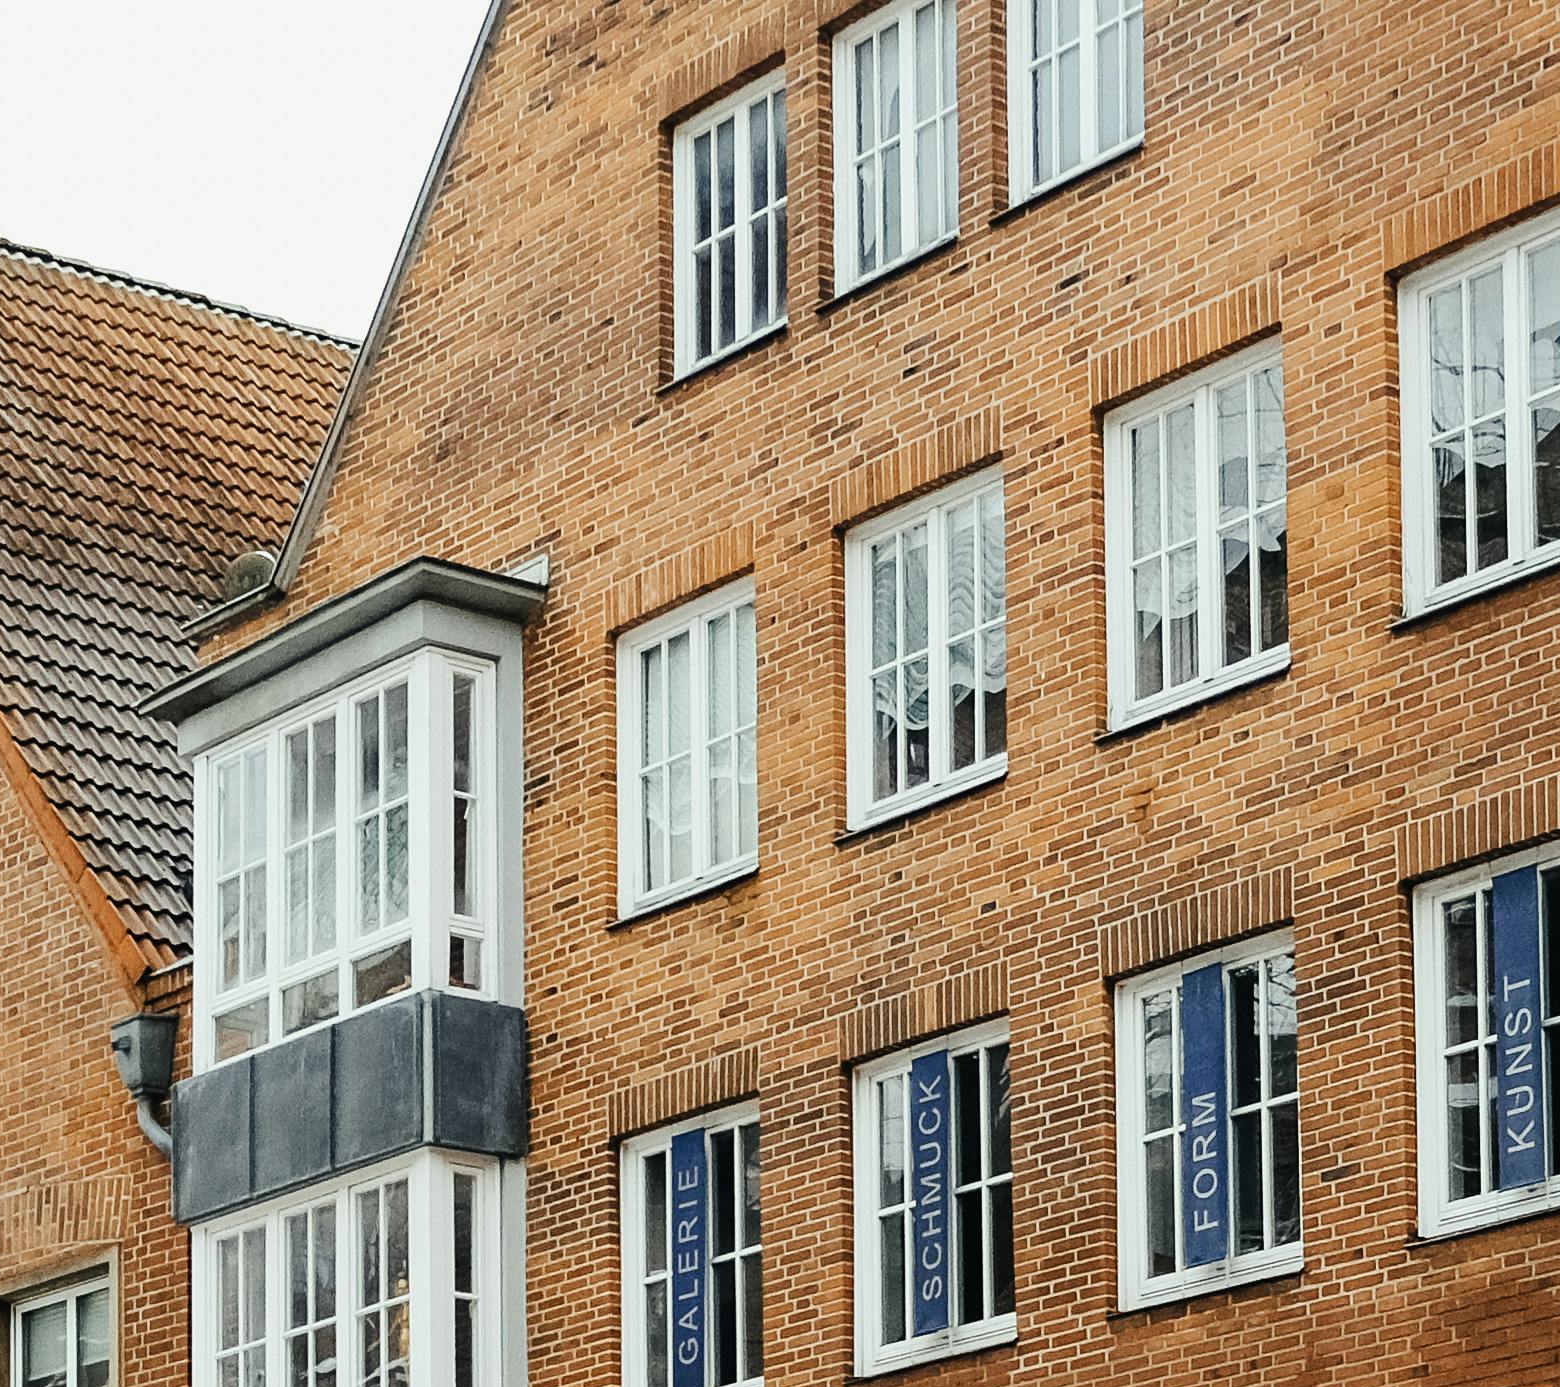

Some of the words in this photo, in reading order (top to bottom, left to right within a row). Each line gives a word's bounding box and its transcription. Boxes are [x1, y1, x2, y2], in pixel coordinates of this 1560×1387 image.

[1502, 974, 1535, 1154] KUNST
[918, 1075, 943, 1301] SCHMUCK
[1191, 1091, 1219, 1233] FORM
[678, 1165, 699, 1366] GALERIE
